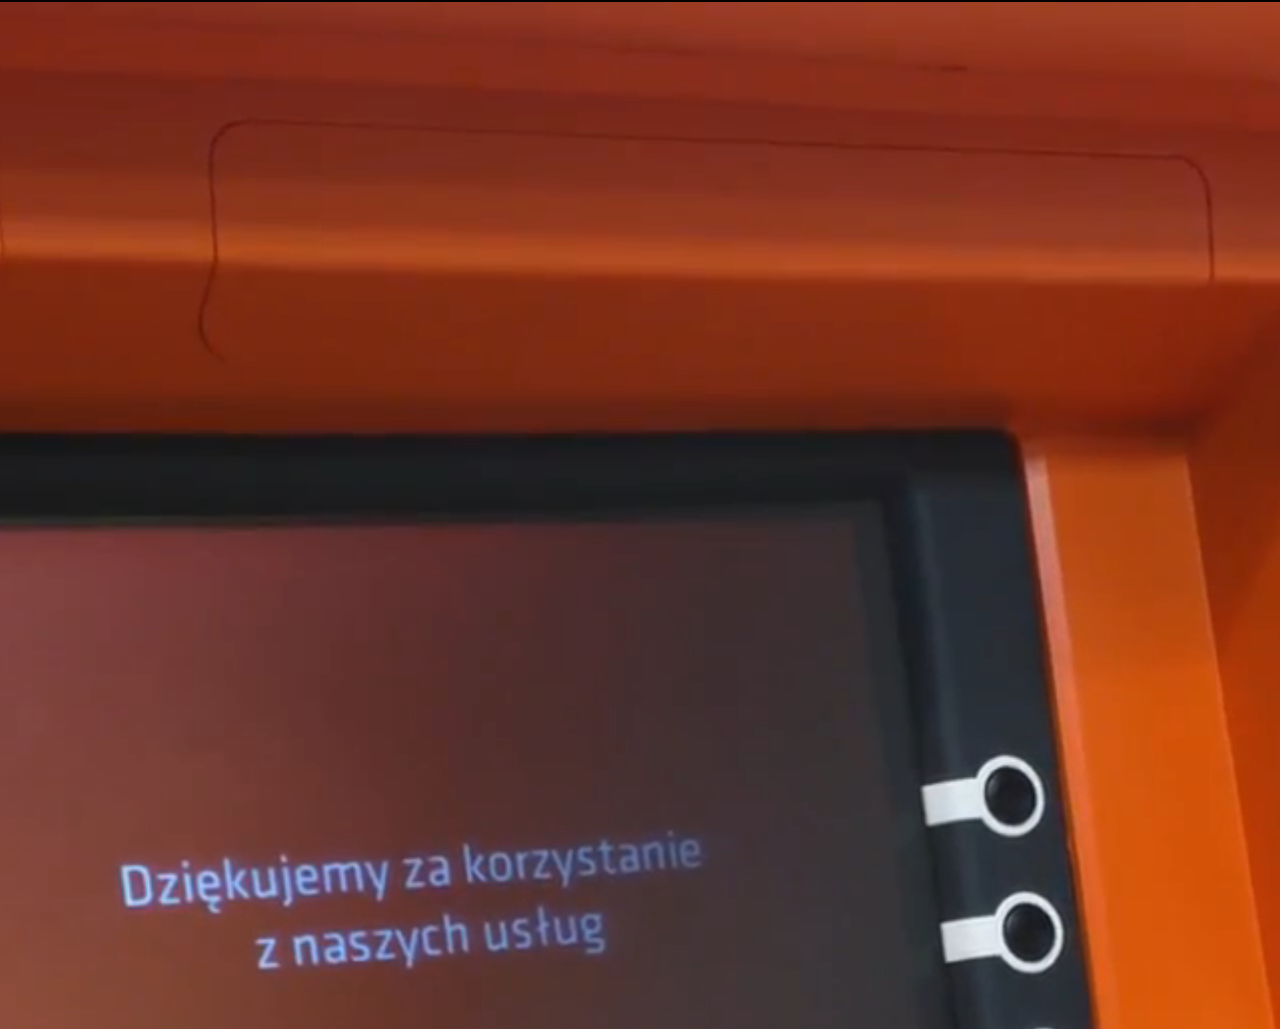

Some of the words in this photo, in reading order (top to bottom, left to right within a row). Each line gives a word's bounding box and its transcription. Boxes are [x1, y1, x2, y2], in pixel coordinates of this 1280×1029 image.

[120, 855, 389, 913] Dziękujemy
[403, 856, 451, 889] za
[463, 831, 703, 888] korzystanie
[256, 934, 280, 970] z
[292, 914, 469, 969] naszych
[484, 906, 606, 955] usług
